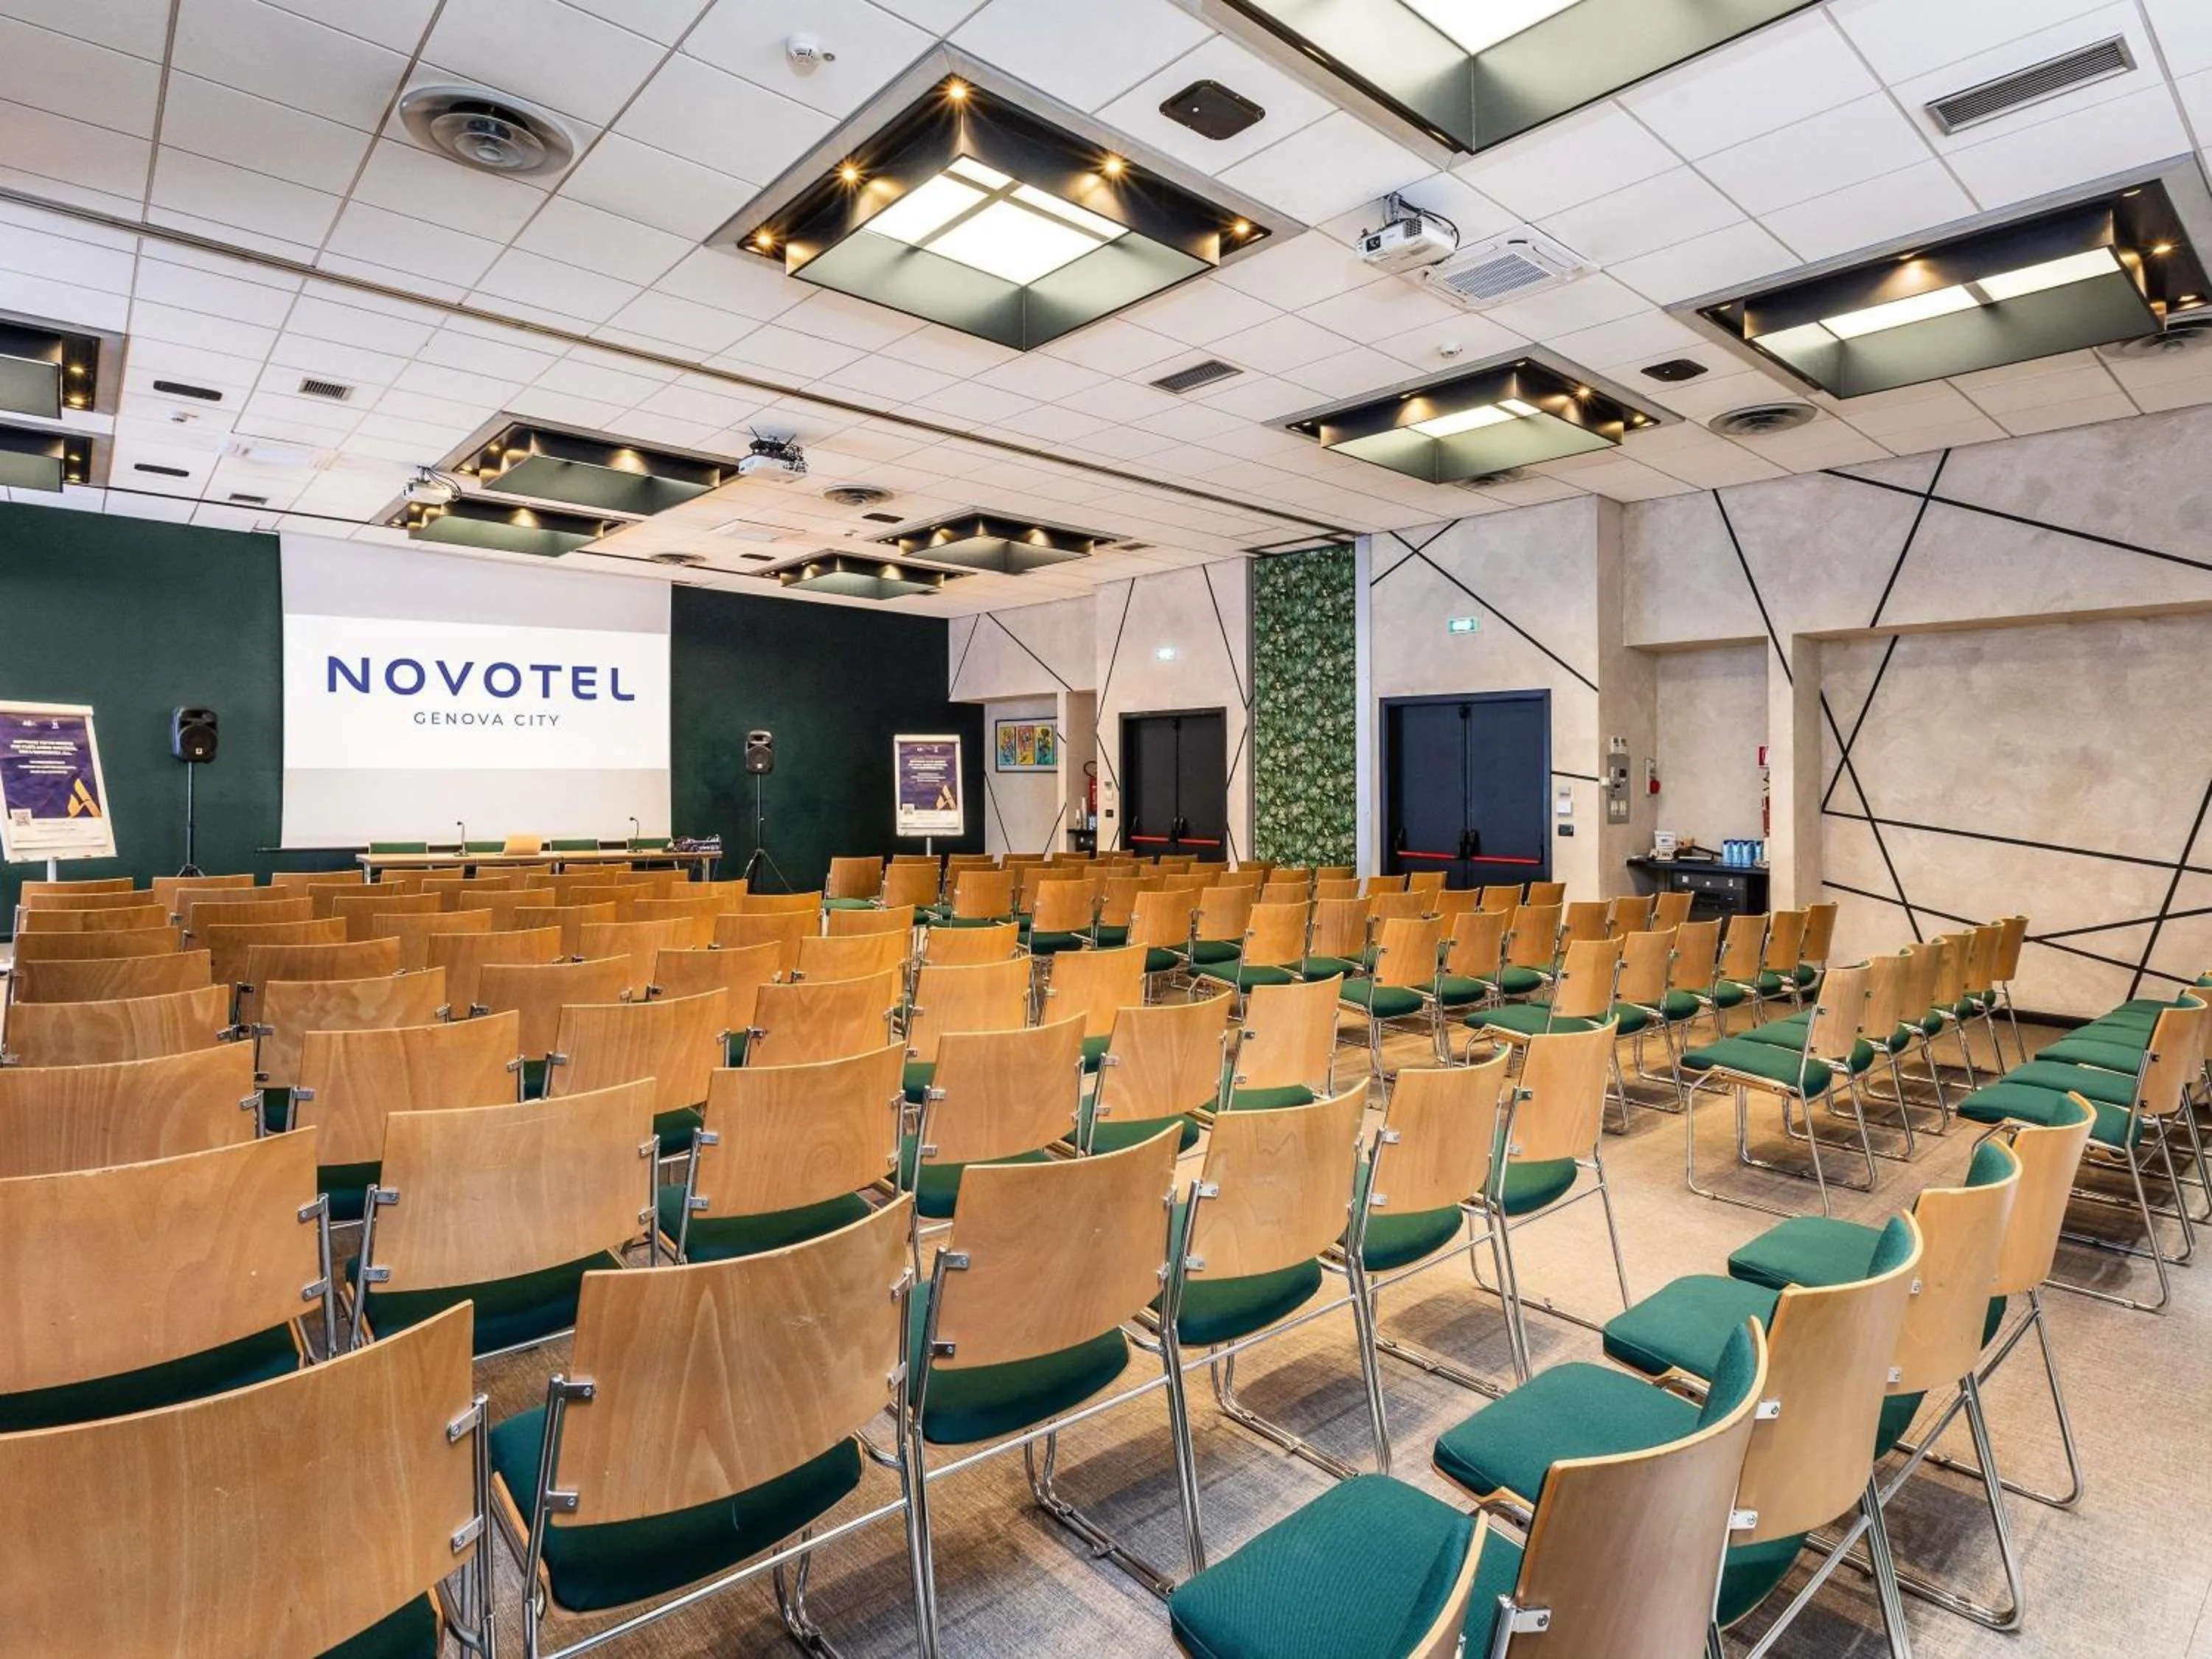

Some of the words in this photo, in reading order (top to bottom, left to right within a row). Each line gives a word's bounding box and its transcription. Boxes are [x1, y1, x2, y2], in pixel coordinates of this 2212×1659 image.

[328, 656, 635, 701] NOVOTEL
[414, 712, 504, 726] GENOVA
[515, 714, 559, 726] CITY
